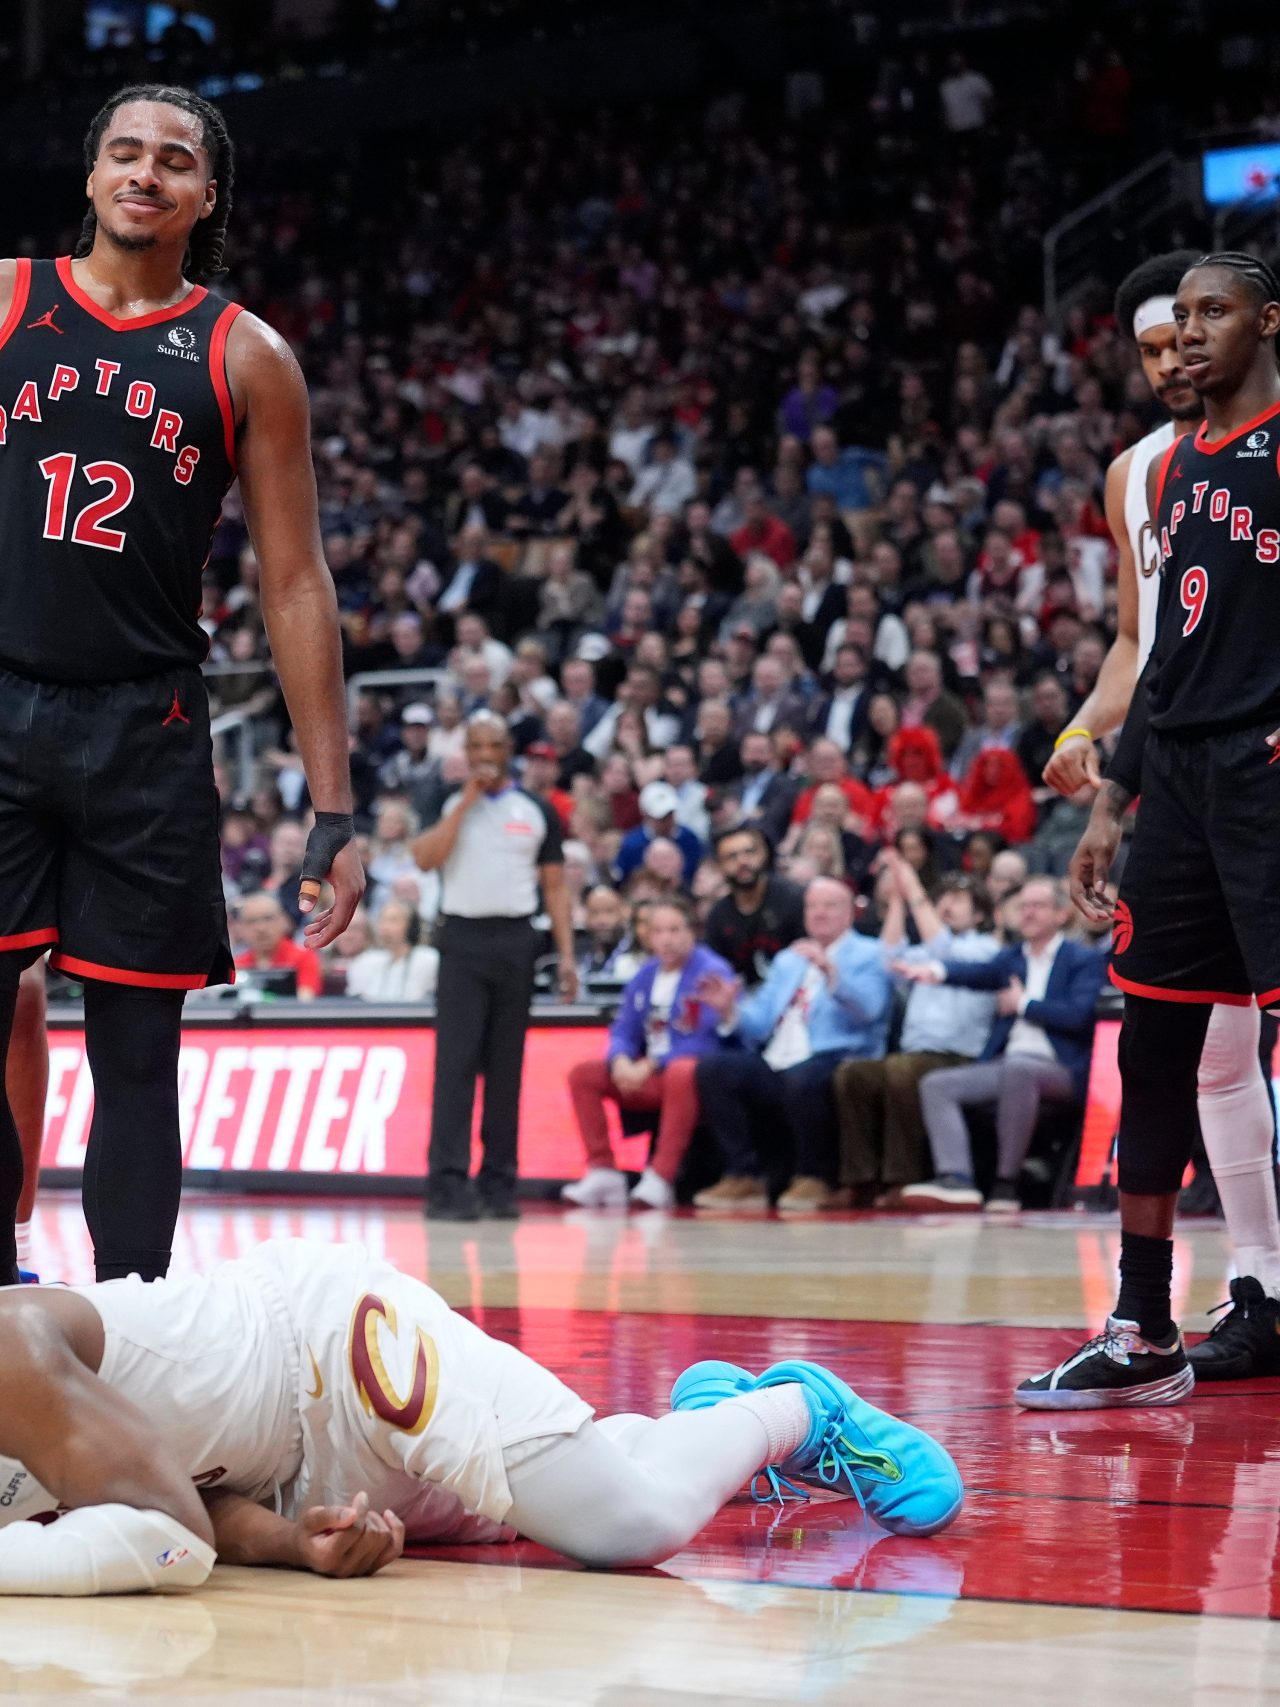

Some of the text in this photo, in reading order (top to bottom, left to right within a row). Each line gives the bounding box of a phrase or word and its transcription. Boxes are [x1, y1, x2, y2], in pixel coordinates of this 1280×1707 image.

[157, 344, 200, 363] Sun Life
[1235, 449, 1270, 458] Sun Life
[38, 452, 134, 552] 12
[1161, 481, 1280, 565] APTORS
[1180, 565, 1209, 637] 9
[44, 1047, 96, 1168] FL
[348, 1291, 439, 1437] C
[0, 1472, 27, 1506] CLIFFS
